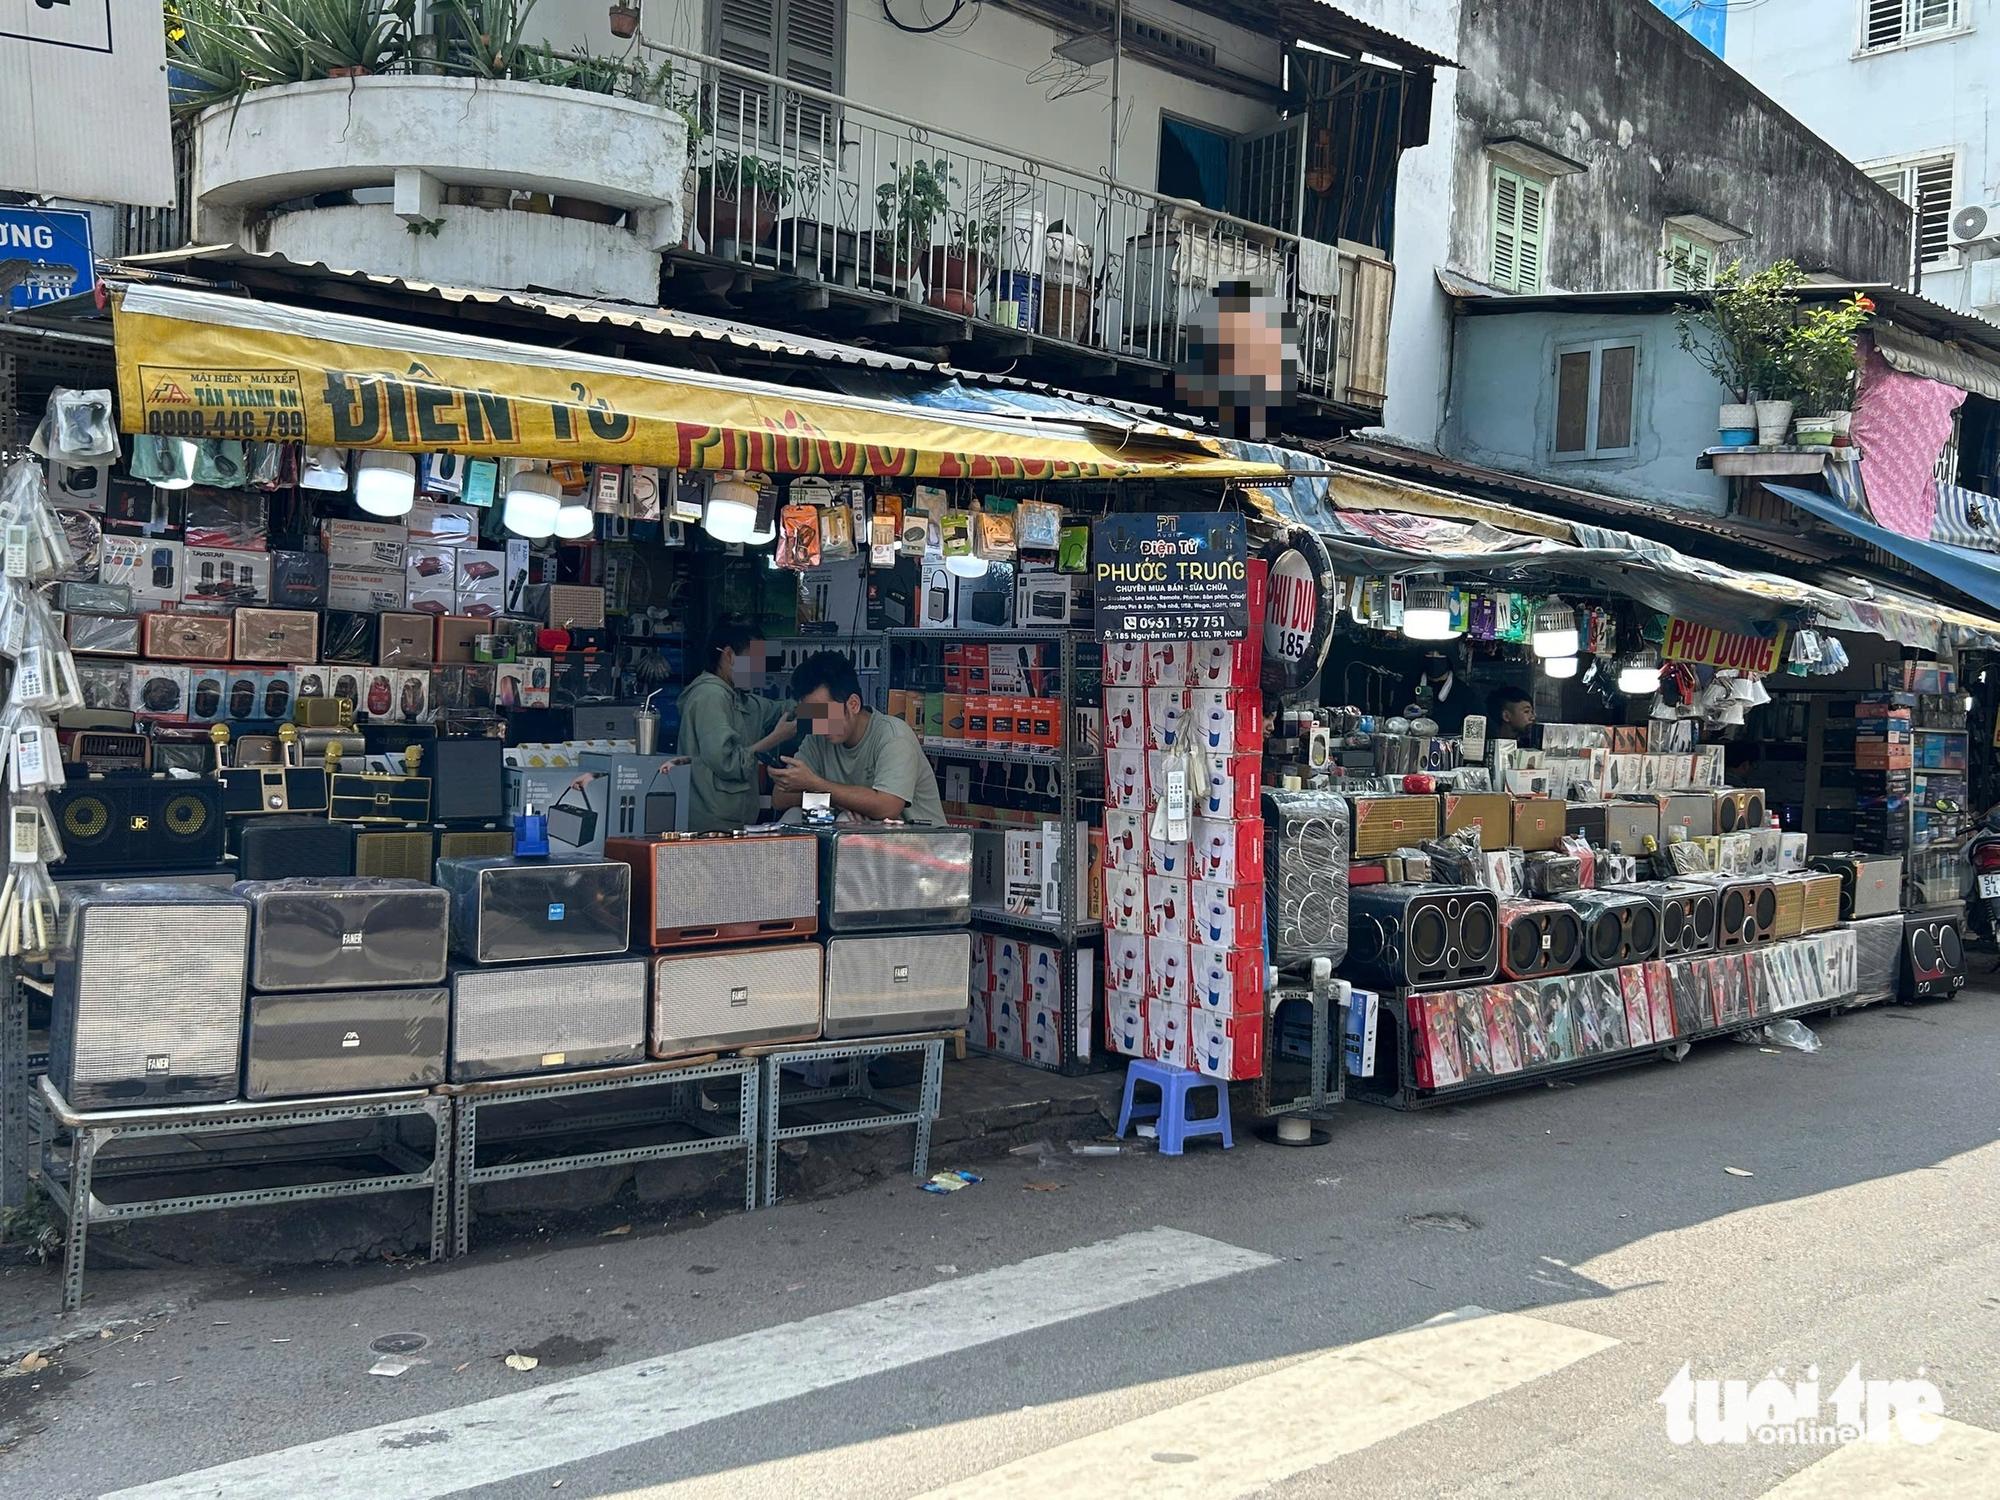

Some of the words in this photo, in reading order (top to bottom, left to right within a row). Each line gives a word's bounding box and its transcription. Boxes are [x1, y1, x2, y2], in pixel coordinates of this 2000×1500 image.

[190, 373, 212, 382] MÁI
[214, 373, 242, 383] HIÊN
[251, 374, 271, 383] MÁI
[273, 372, 296, 384] XẾP
[194, 383, 224, 406] TÂN
[227, 385, 277, 407] THÀNH
[280, 388, 298, 407] AN
[333, 522, 362, 532] DIGITAL
[363, 526, 386, 534] MIXER
[1157, 515, 1180, 532] PT
[1140, 540, 1176, 558] Điện
[1179, 538, 1198, 555] Tử
[192, 550, 225, 559] TAKSTAR
[1097, 557, 1167, 582] PHƯỚC
[1176, 561, 1245, 581] TRUNG
[331, 573, 359, 581] DIGITAL
[1115, 584, 1147, 593] CHUYÊN
[1168, 583, 1184, 592] BÁN
[1206, 583, 1228, 592] CHỮA
[1203, 616, 1225, 628] 751
[1115, 632, 1129, 640] 185
[1162, 631, 1177, 639] Kim
[1213, 630, 1223, 638] TP.
[1224, 630, 1243, 638] HCM
[1278, 631, 1304, 658] 185
[1668, 619, 1713, 662] PHU
[1713, 630, 1776, 672] DUNG
[342, 933, 363, 945] FANER
[147, 1057, 169, 1070] FANER
